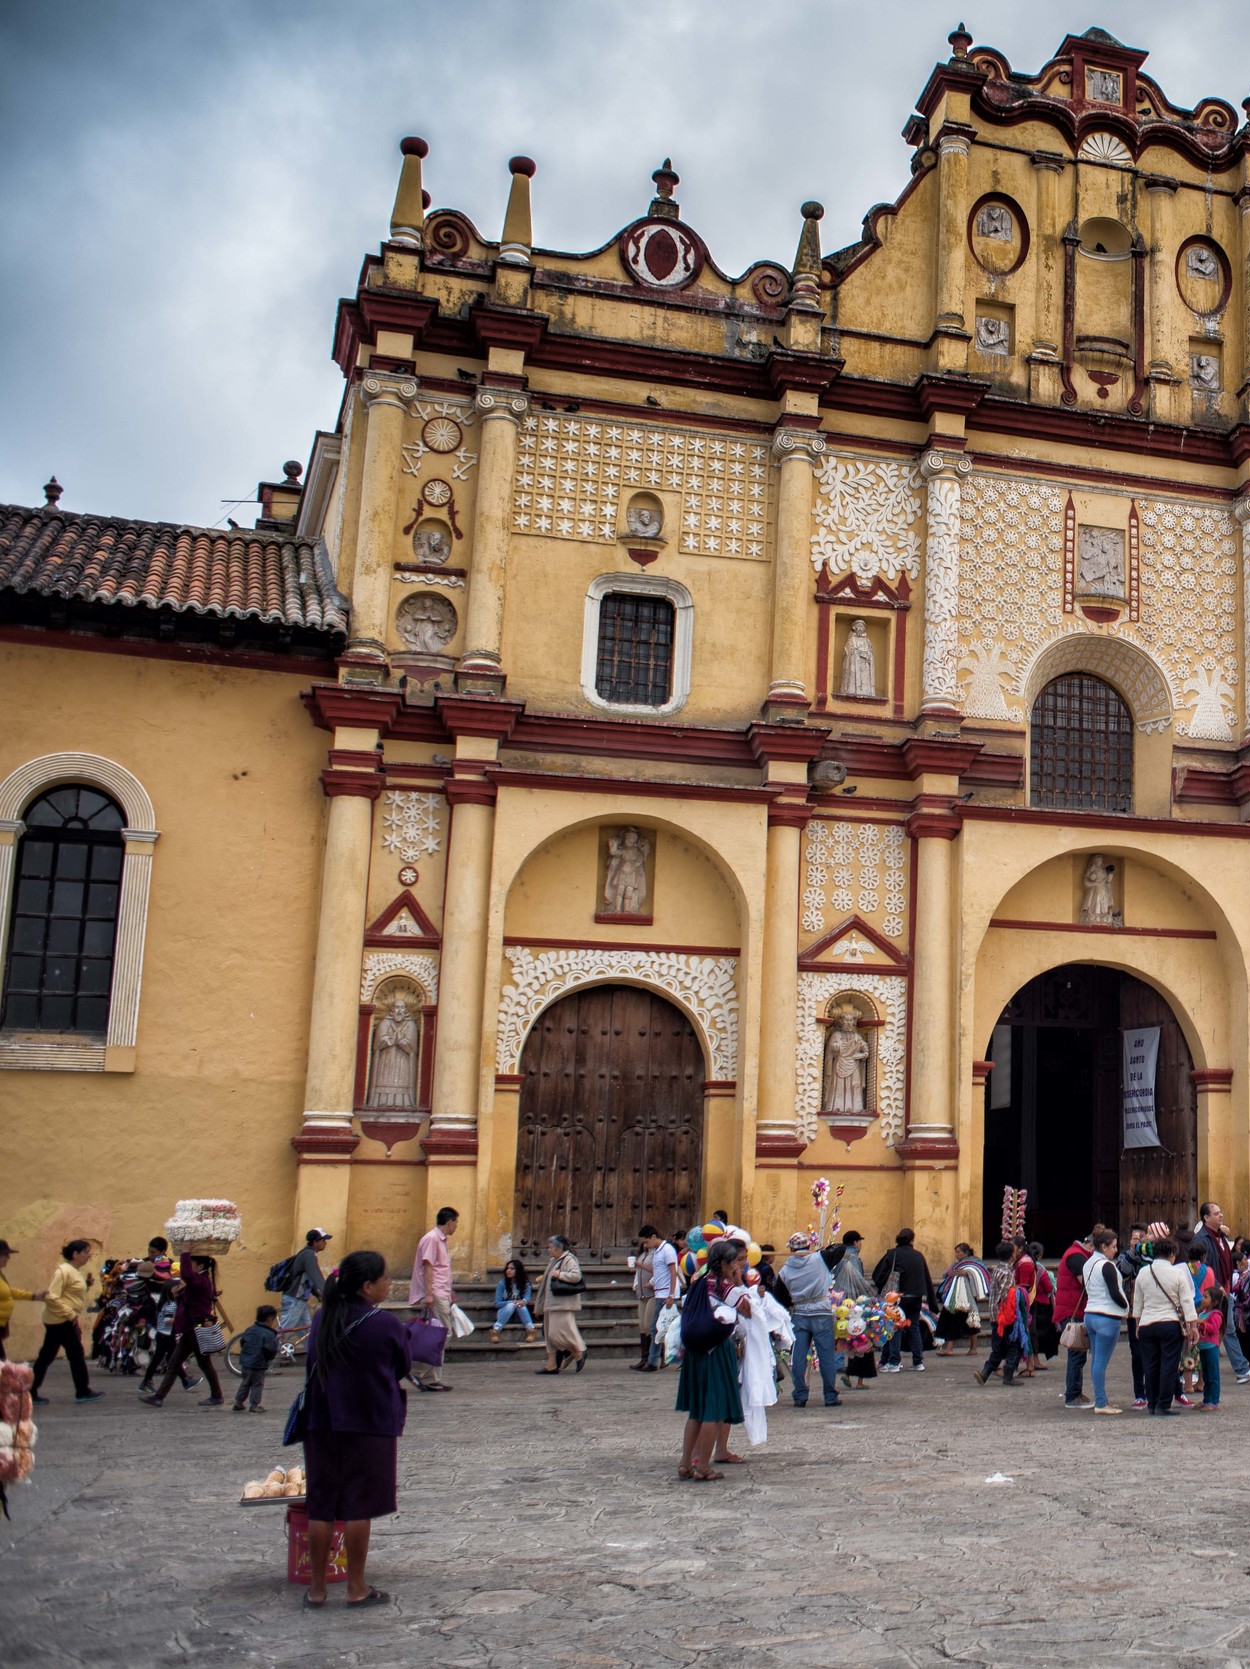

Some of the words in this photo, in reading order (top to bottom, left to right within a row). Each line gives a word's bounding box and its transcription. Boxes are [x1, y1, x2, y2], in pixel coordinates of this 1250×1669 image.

[1130, 1055, 1145, 1065] SANTO
[1130, 1072, 1136, 1081] DE
[1137, 1072, 1143, 1080] LA
